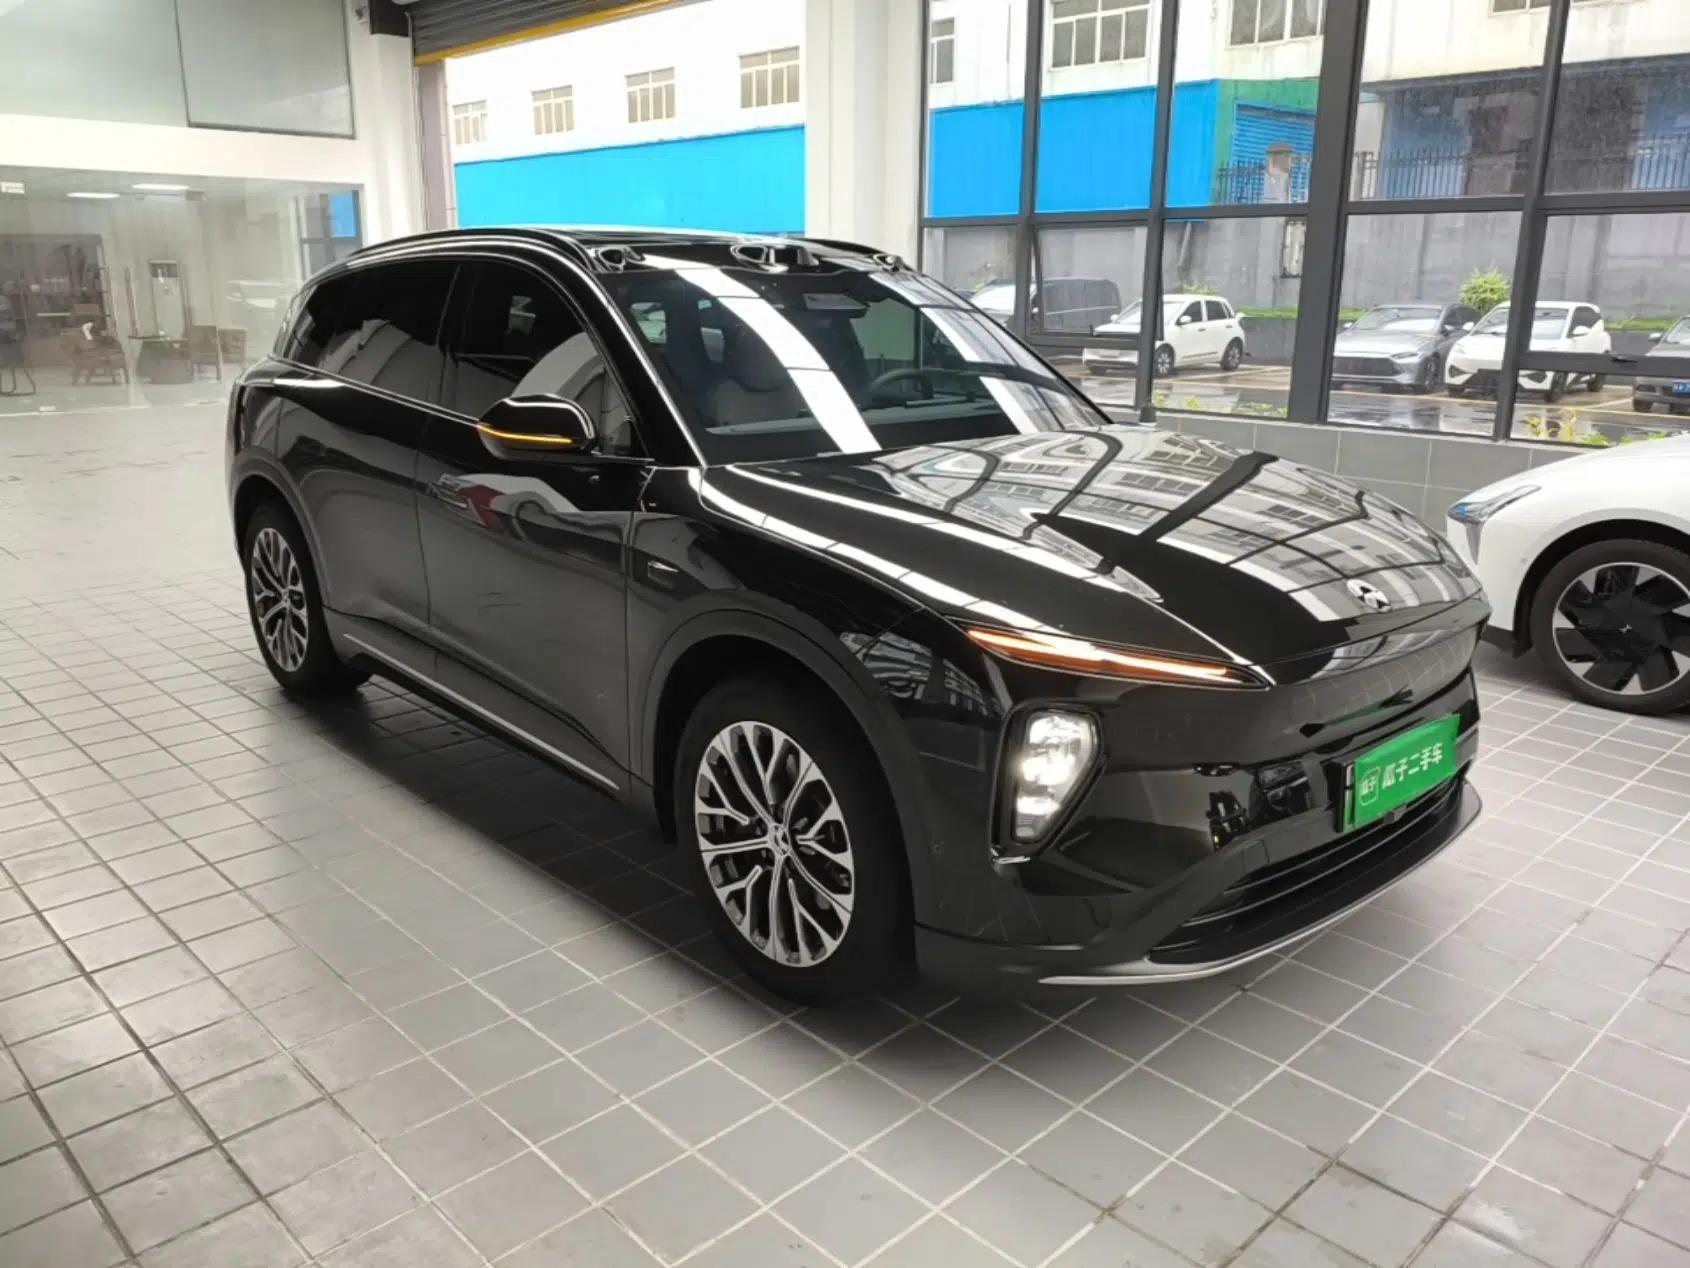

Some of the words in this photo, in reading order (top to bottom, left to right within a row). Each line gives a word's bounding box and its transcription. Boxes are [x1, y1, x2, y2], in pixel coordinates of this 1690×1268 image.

[1381, 742, 1443, 789] 瓜子二手车
